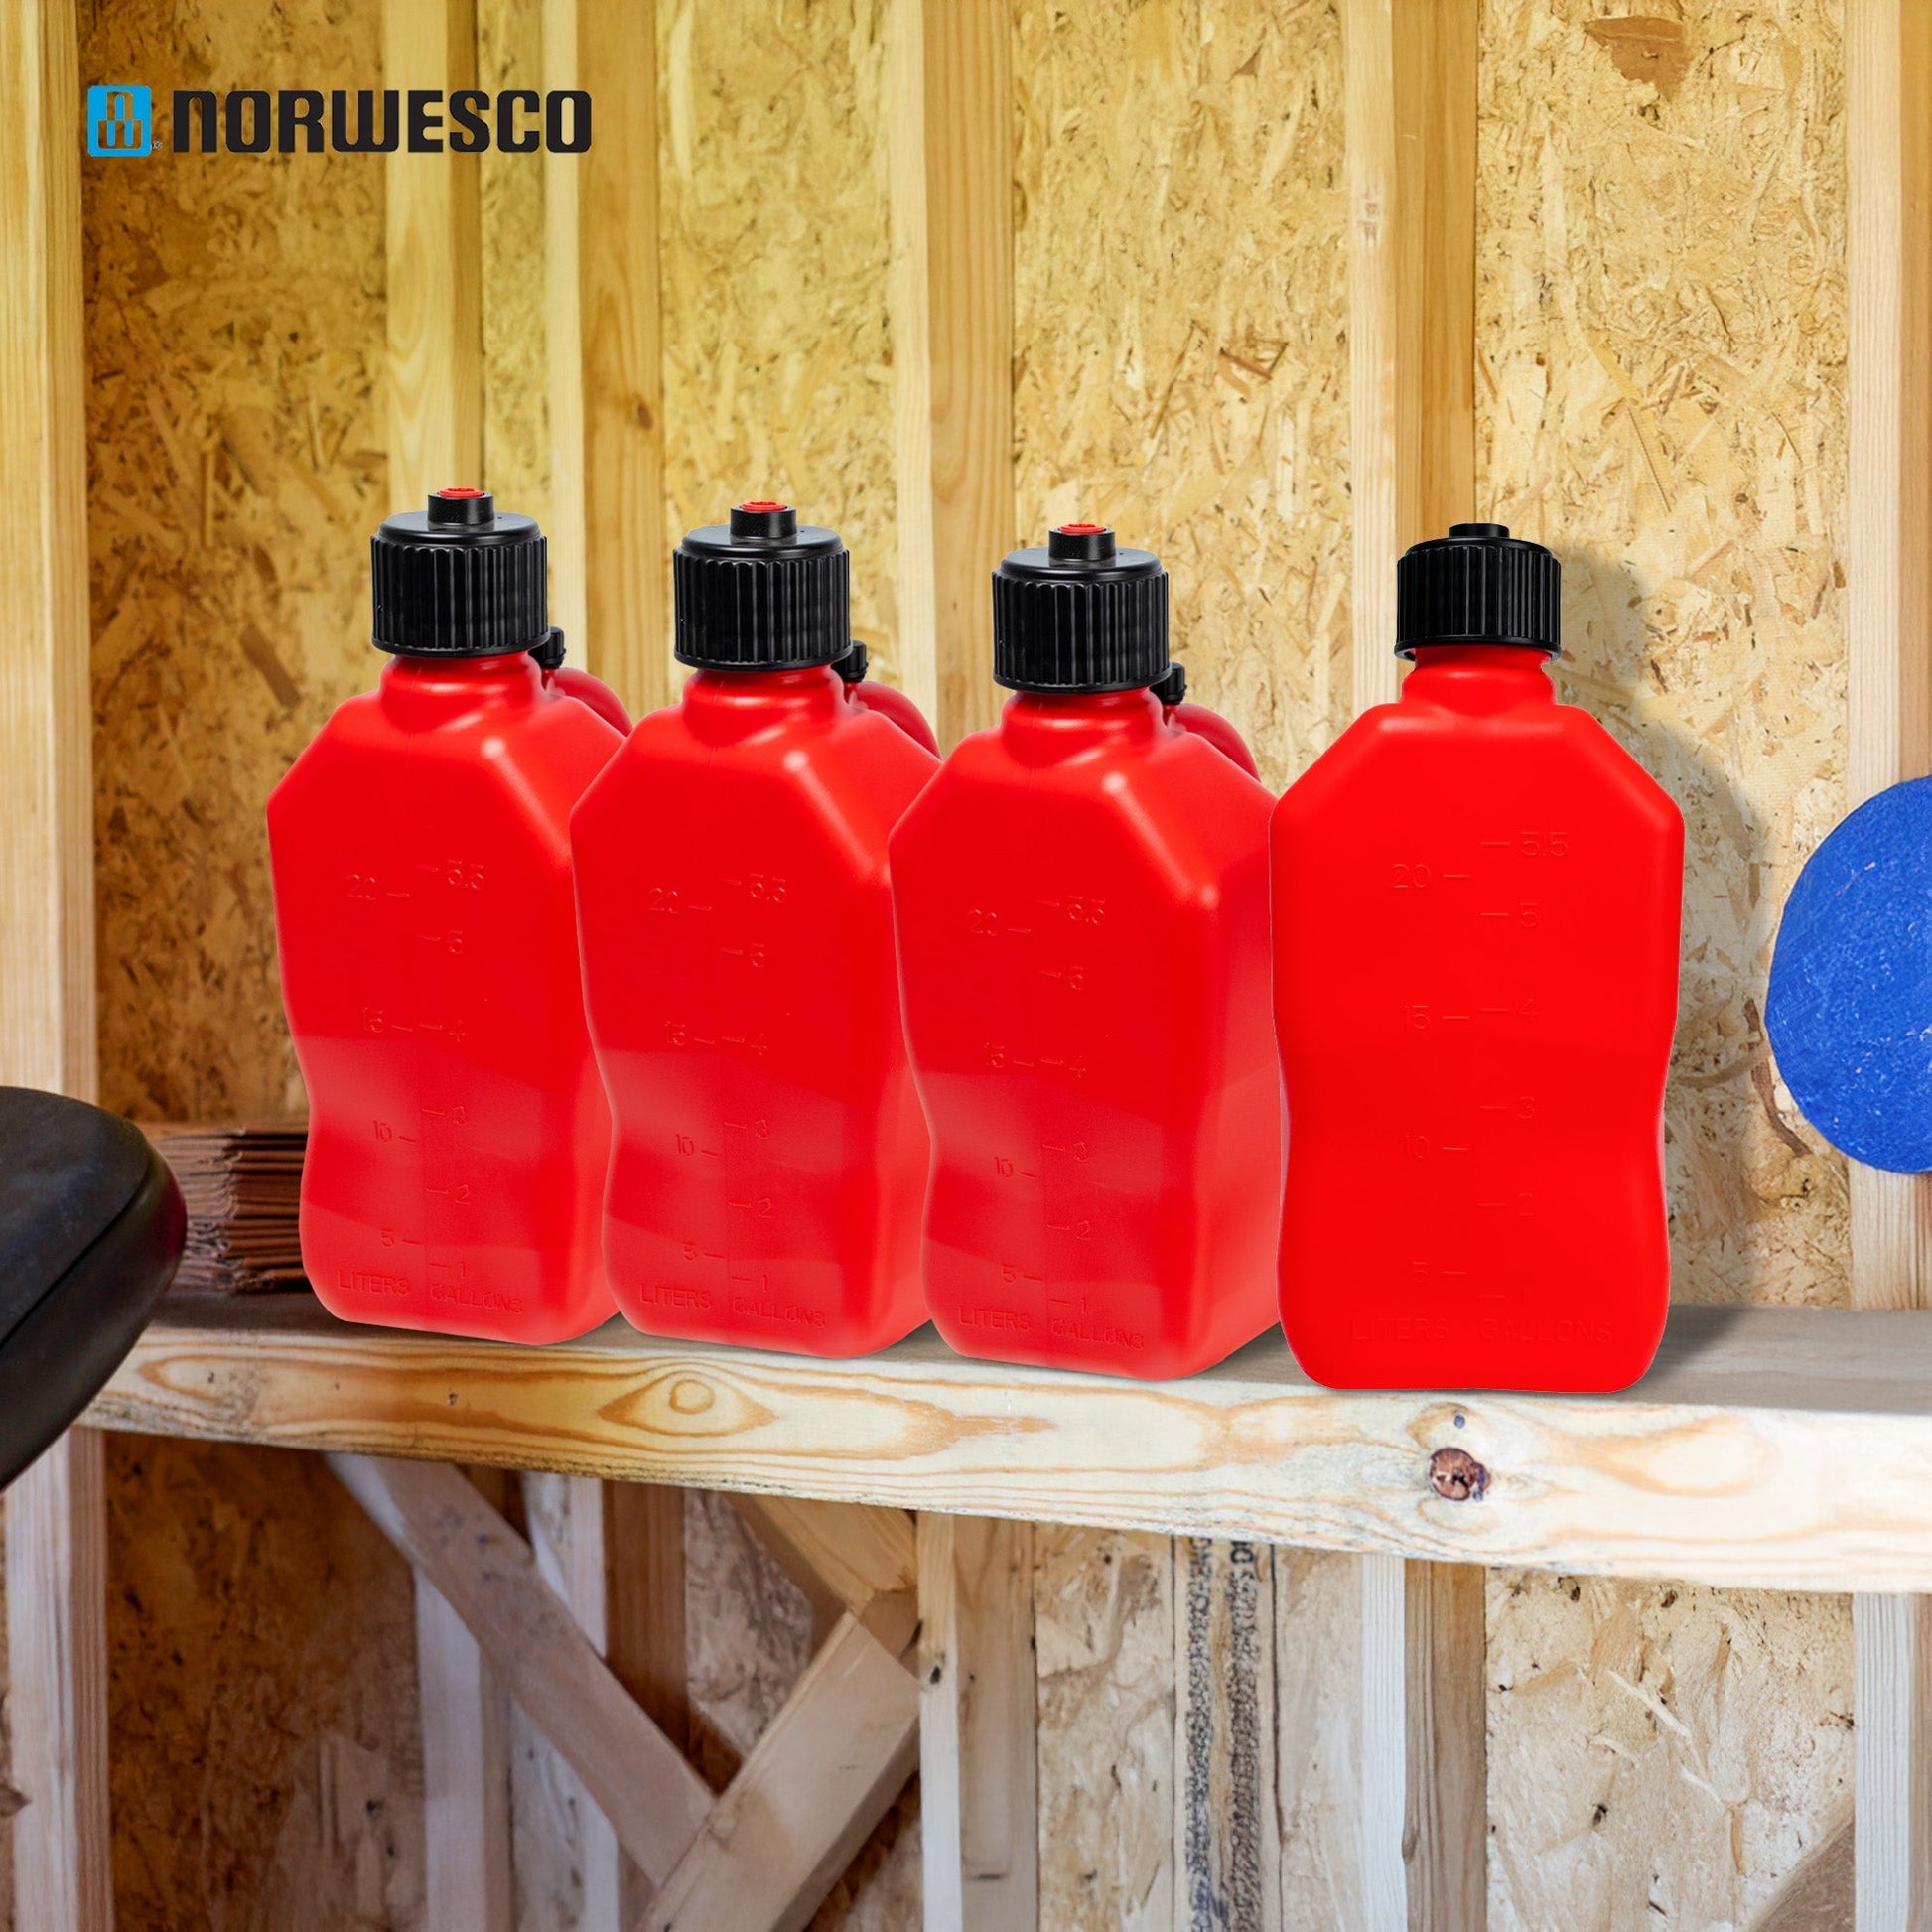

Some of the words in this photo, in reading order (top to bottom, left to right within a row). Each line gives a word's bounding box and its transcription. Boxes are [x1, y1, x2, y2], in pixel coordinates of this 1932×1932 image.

[337, 1269, 411, 1297] LITERS
[431, 1285, 525, 1315] GALLONS
[639, 1284, 712, 1311] LITERS
[733, 1299, 826, 1329] GALLONS
[958, 1305, 1031, 1331] LITERS
[1051, 1319, 1145, 1350] GALLONS
[1350, 1317, 1449, 1343] LITERS
[1477, 1317, 1612, 1343] GALLONS
